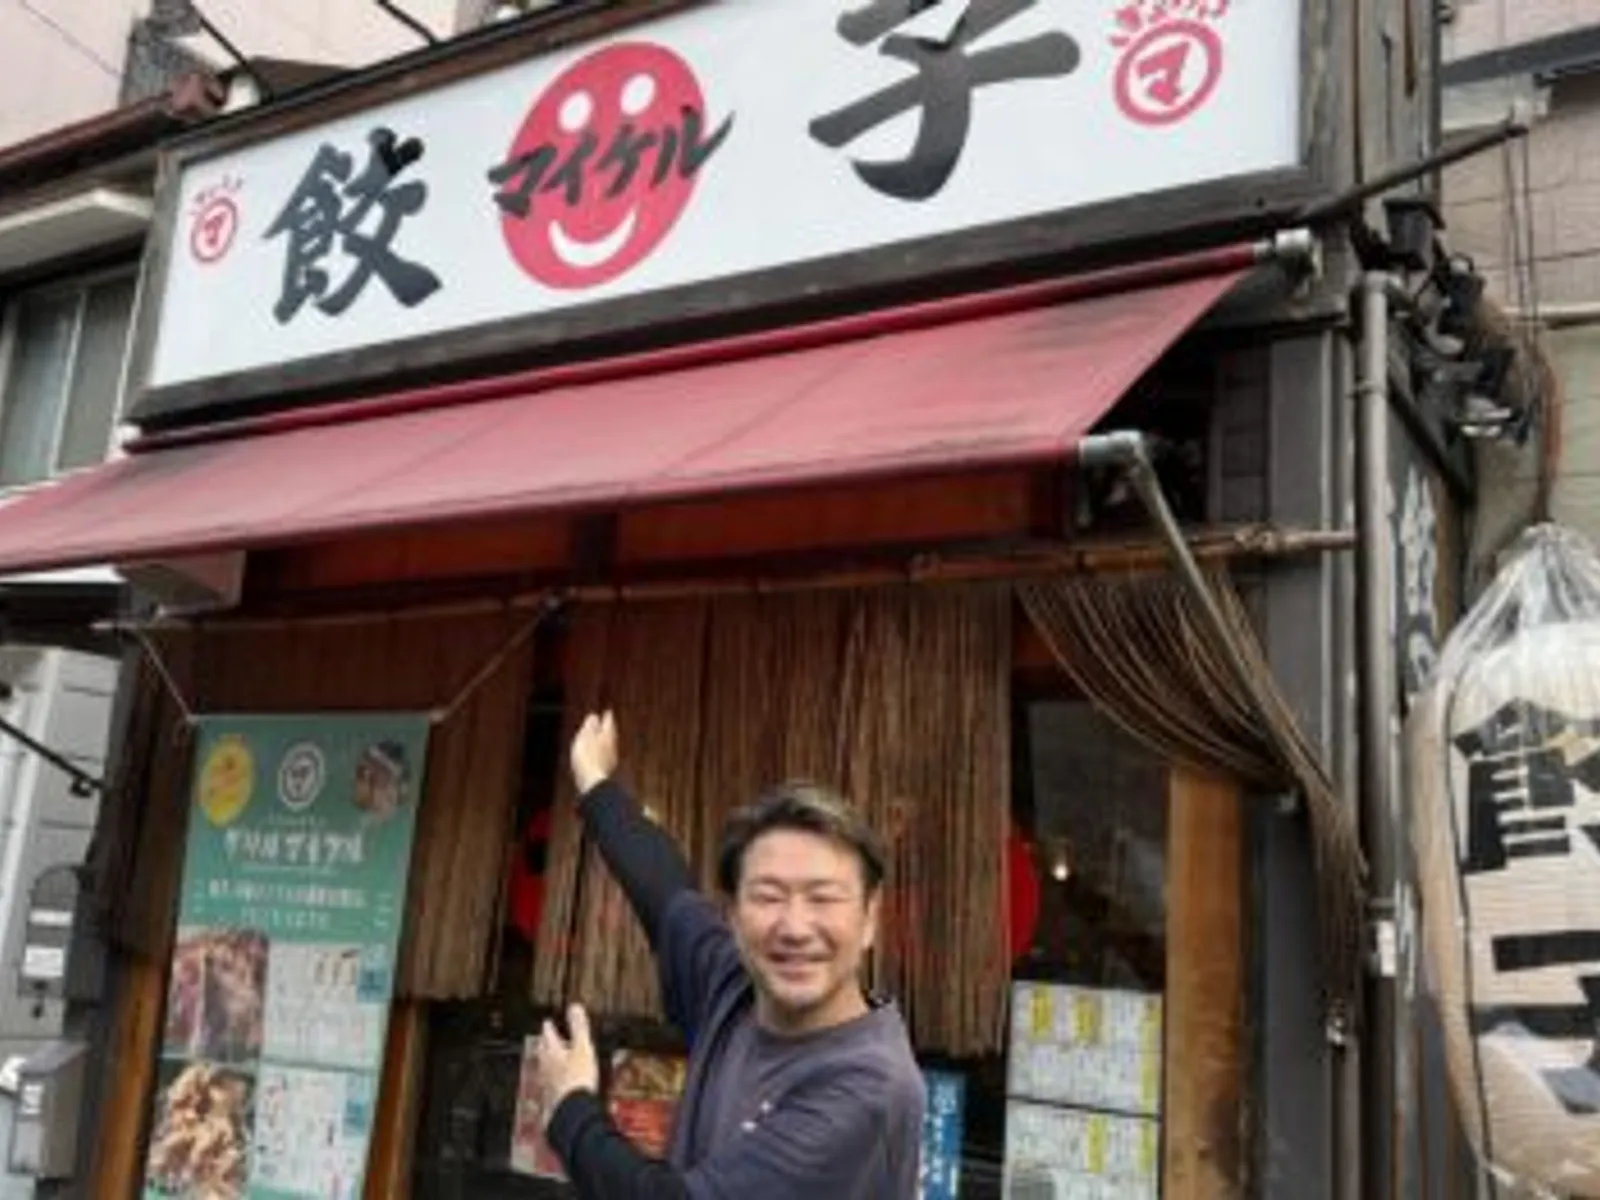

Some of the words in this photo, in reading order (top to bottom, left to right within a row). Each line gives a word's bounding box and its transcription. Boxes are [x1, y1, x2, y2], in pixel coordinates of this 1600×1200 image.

[264, 127, 442, 324] 餃
[487, 104, 736, 219] マイケル
[808, 0, 1080, 202] 子
